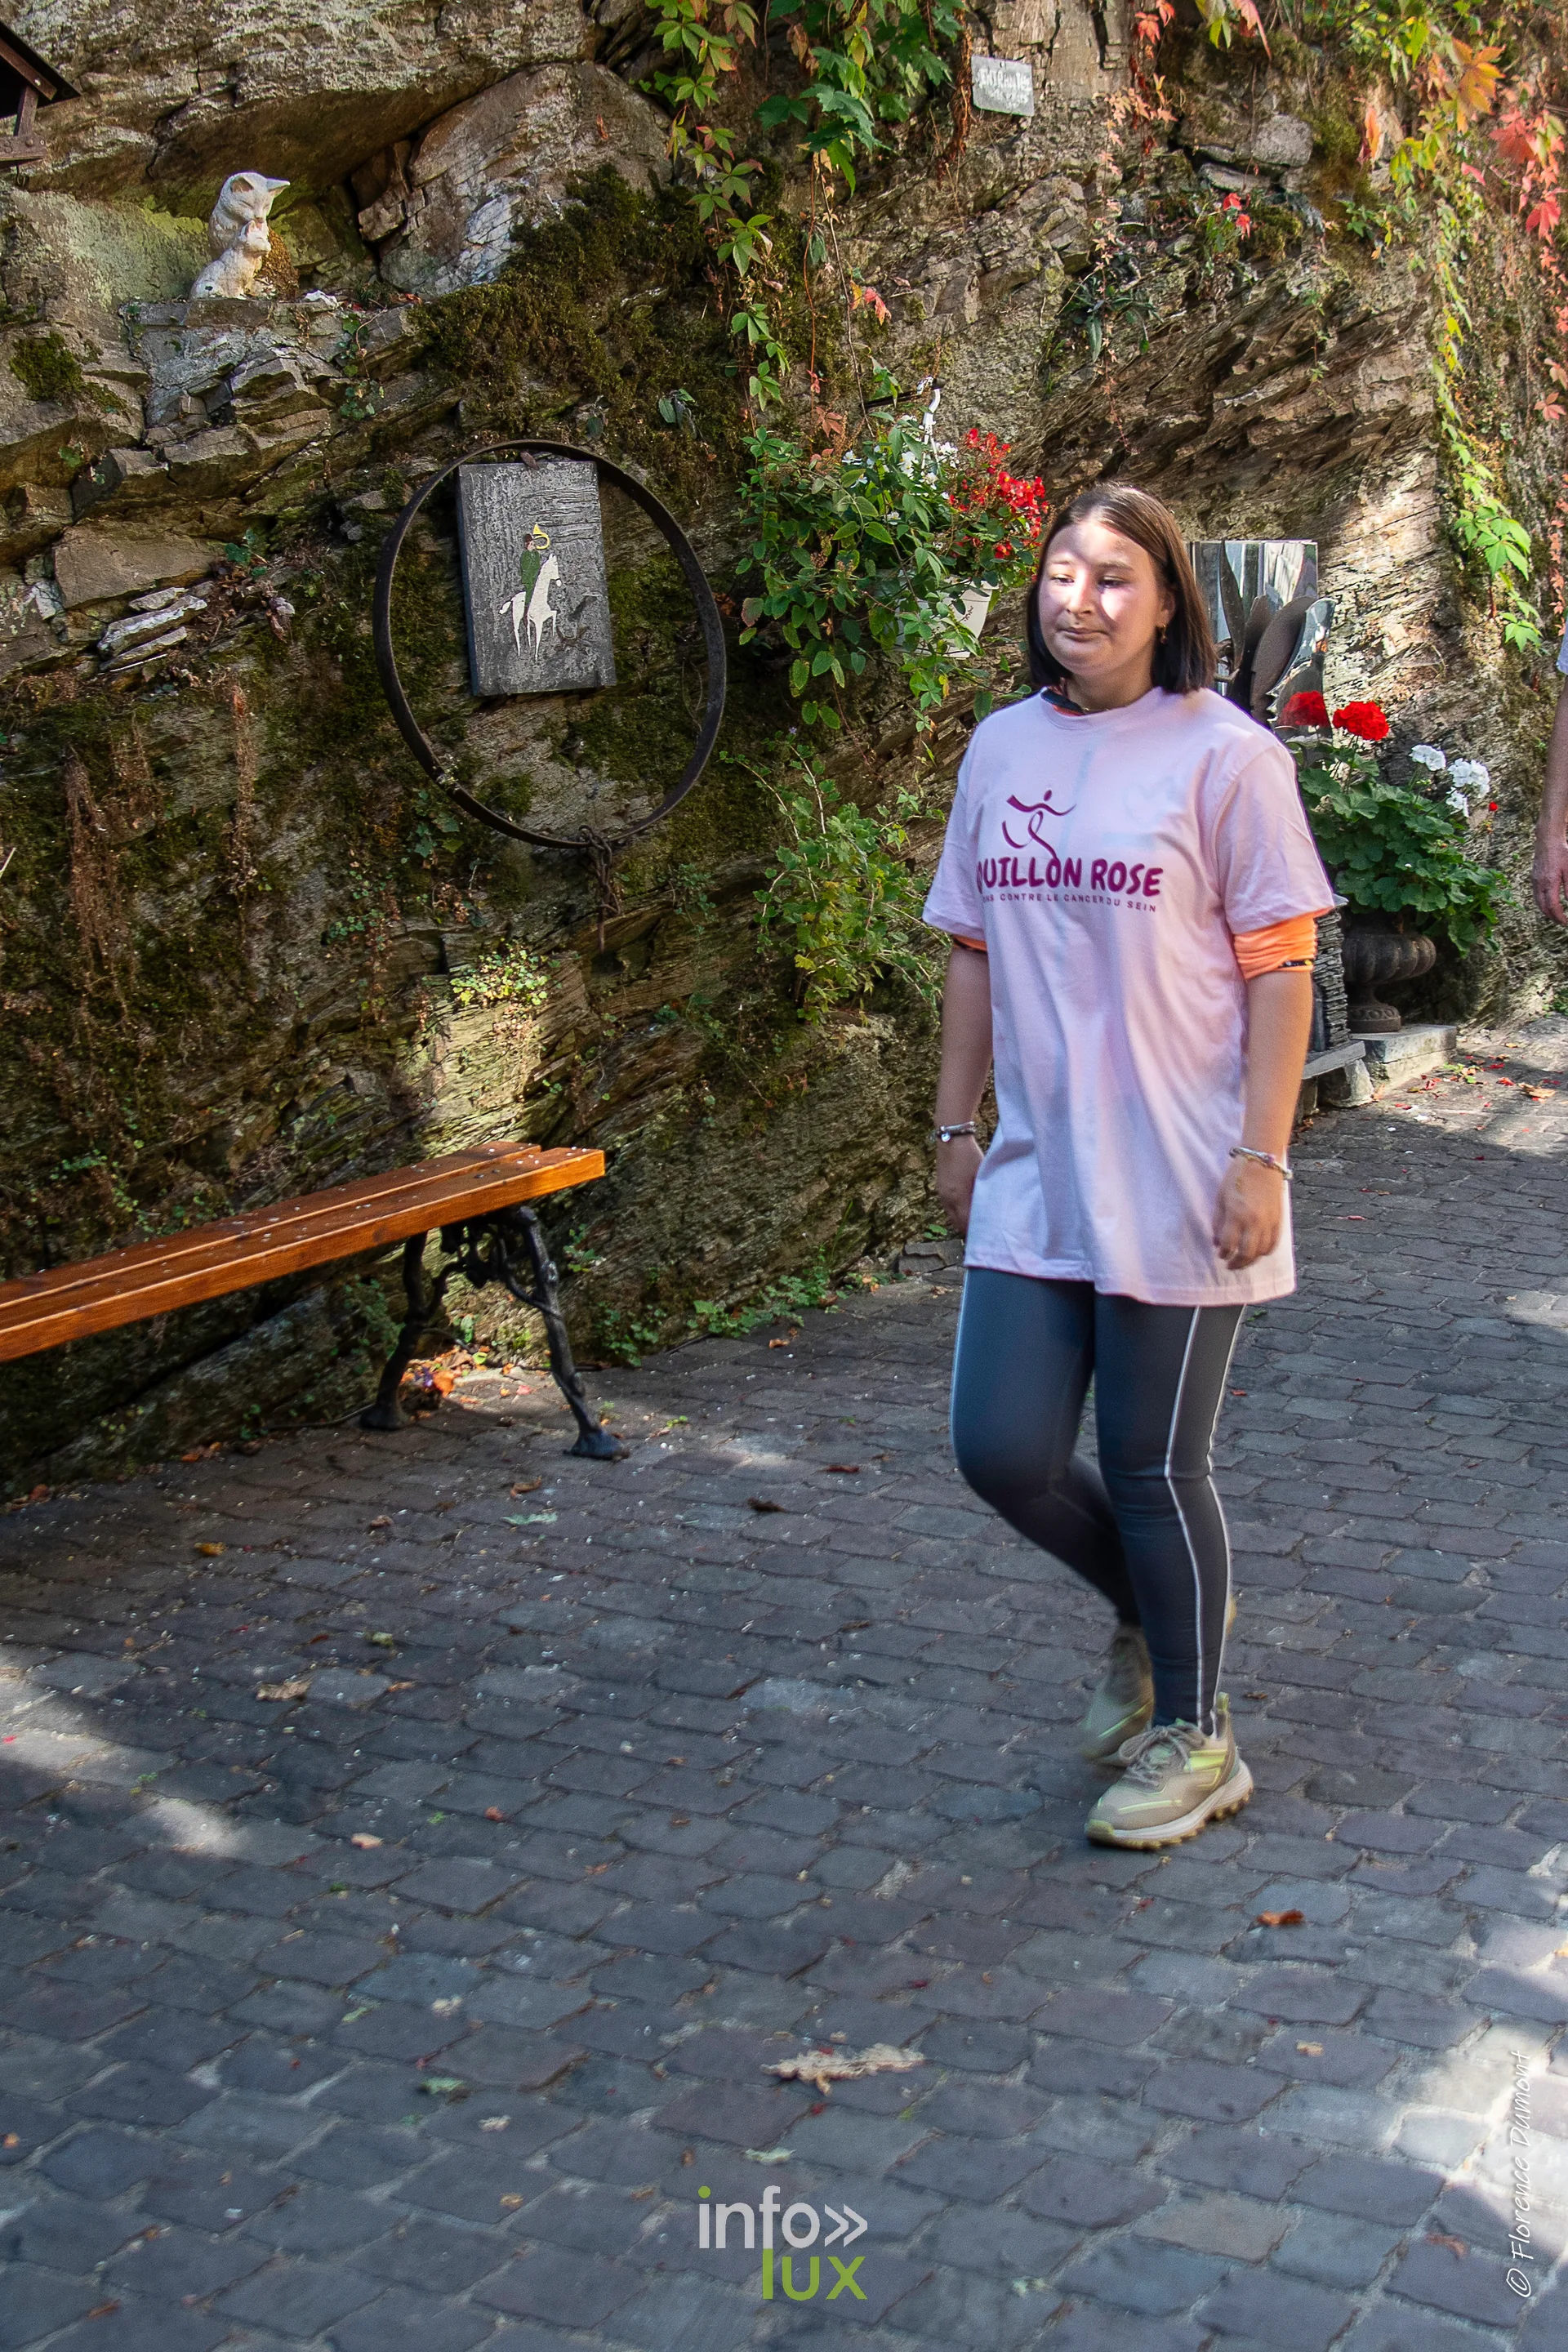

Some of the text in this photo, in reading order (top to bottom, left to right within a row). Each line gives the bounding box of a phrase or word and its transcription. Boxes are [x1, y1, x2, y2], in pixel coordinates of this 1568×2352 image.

[1090, 858, 1164, 897] ROSE
[1000, 893, 1042, 902] CONTRE
[1046, 893, 1059, 902] LE
[1063, 894, 1104, 904] CANCER
[1106, 897, 1120, 906] DU
[1126, 901, 1156, 912] SEIN
